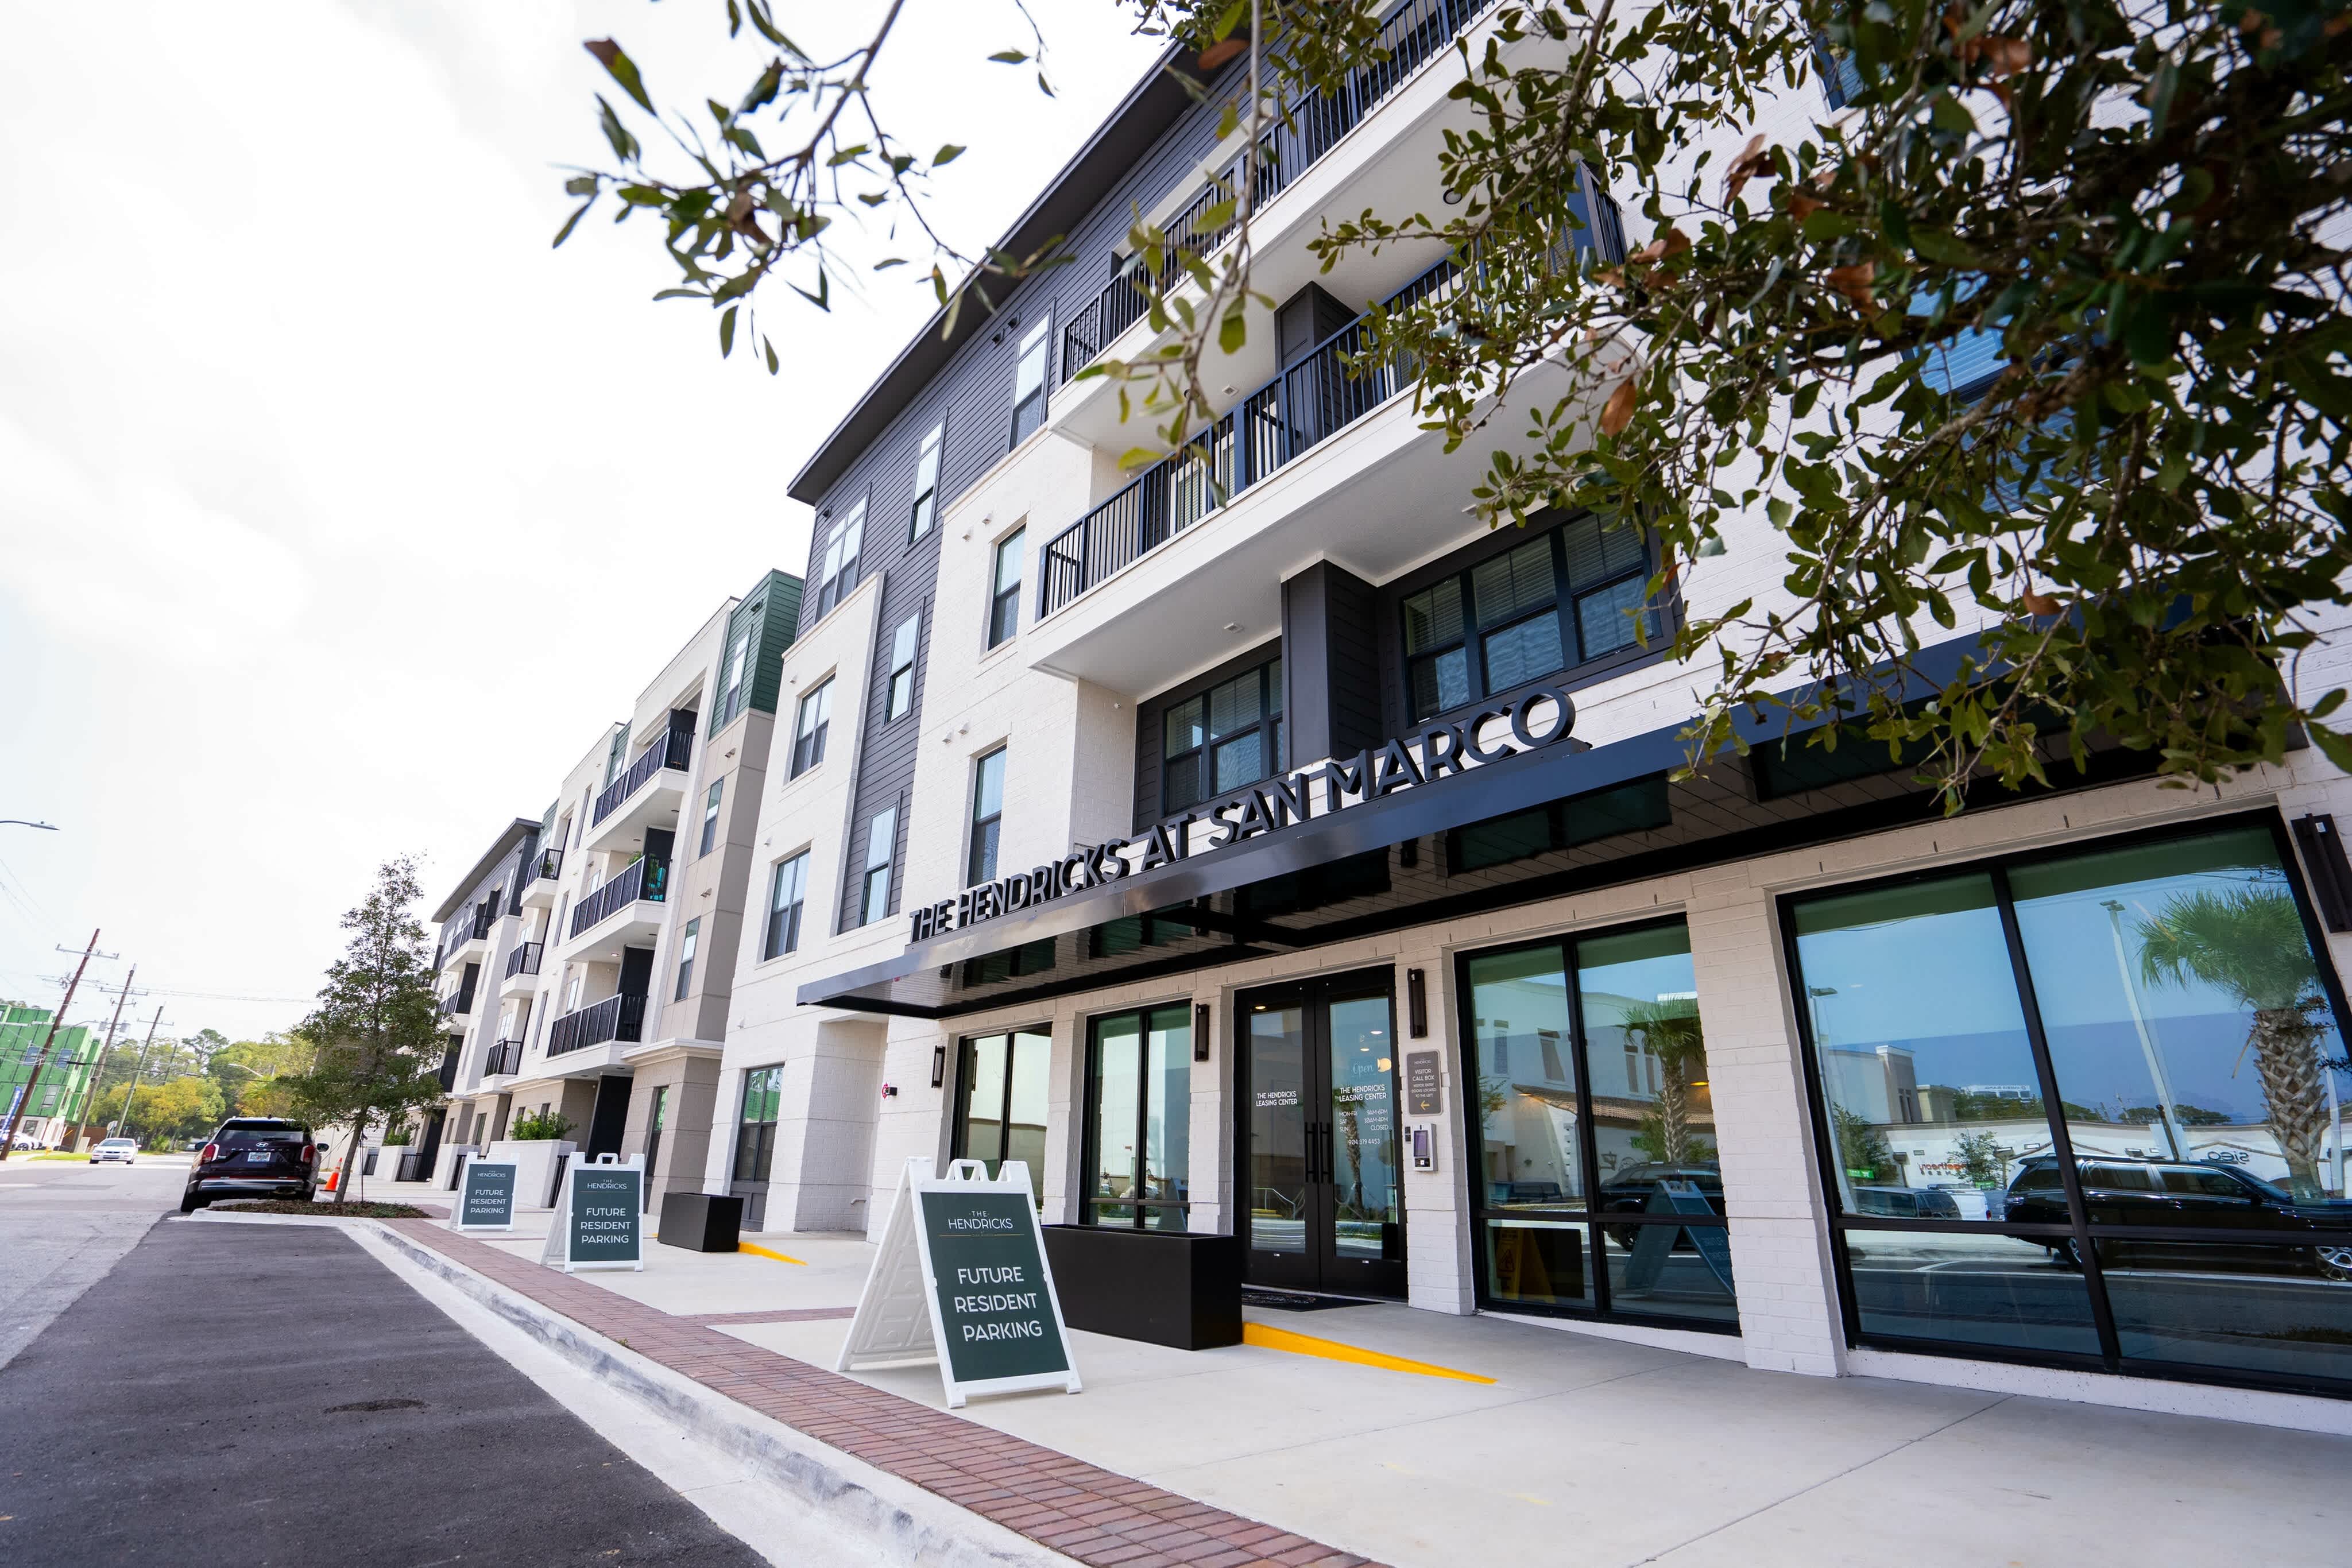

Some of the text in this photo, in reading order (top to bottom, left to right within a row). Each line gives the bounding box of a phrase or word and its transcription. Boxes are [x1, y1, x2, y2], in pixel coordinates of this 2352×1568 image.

[910, 688, 1576, 943] THE HENDRICKS AT SAN MARCO
[1352, 1063, 1374, 1078] Open
[1352, 1084, 1385, 1093] HENDRICKS
[1364, 1093, 1387, 1101] CENTER
[586, 1207, 626, 1216] FUTURE
[580, 1221, 632, 1230] RESIDENT
[948, 1218, 1013, 1229] HENDRICKS
[581, 1234, 629, 1244] PARKING
[957, 1267, 1024, 1285] FUTURE
[954, 1293, 1037, 1314] RESIDENT
[962, 1320, 1043, 1342] PARKING
